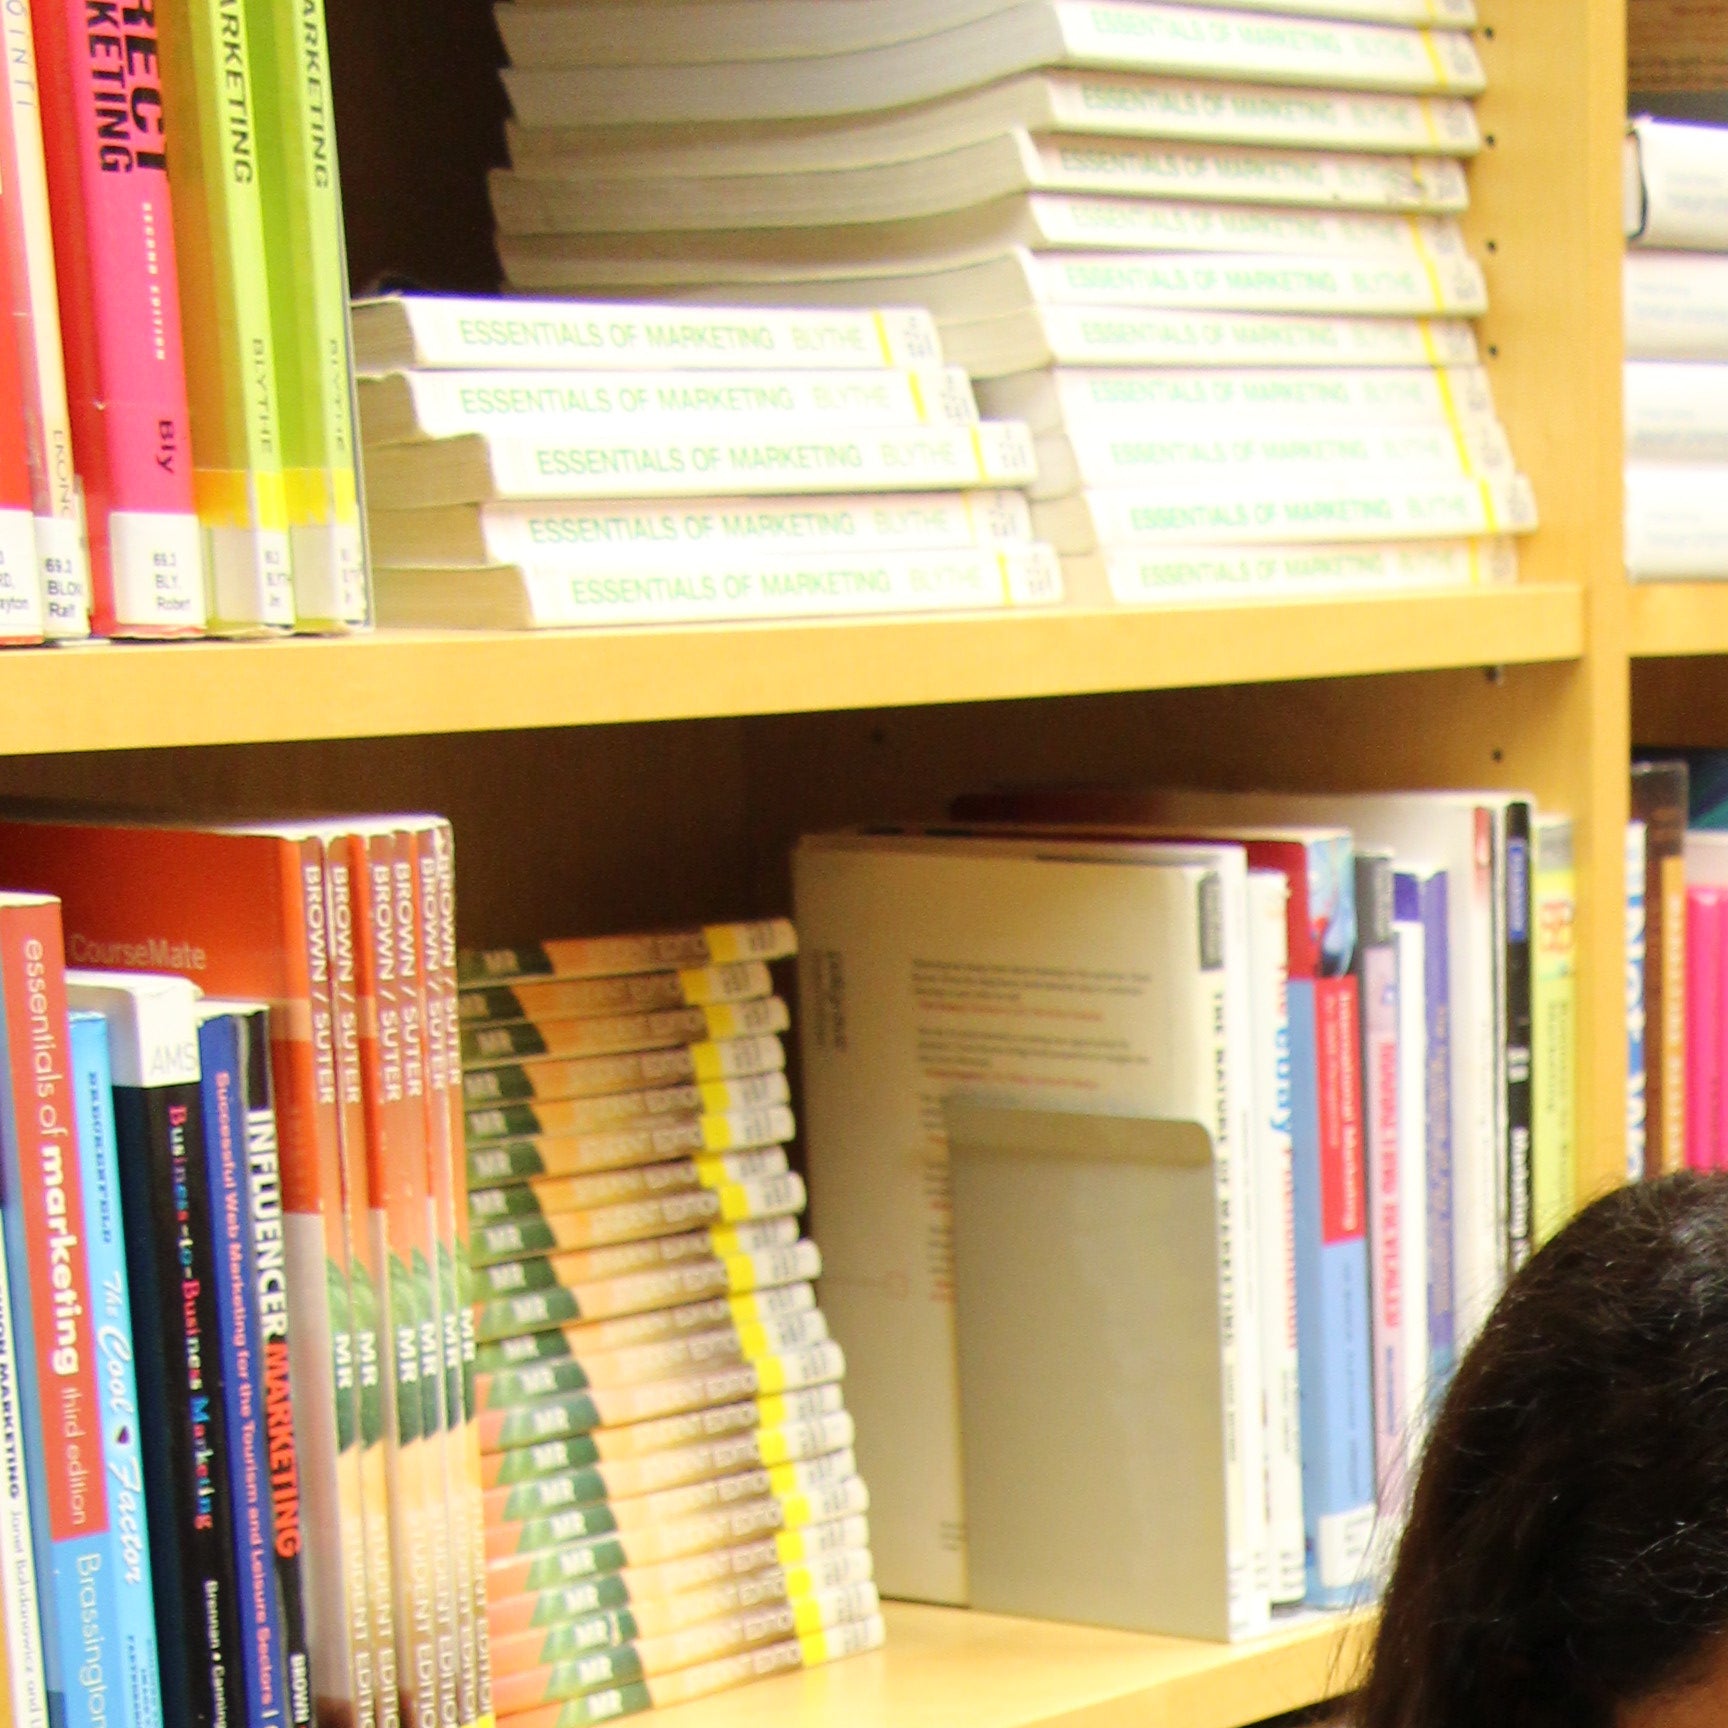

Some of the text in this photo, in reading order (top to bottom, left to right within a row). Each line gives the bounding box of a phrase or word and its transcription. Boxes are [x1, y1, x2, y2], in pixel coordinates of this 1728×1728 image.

[460, 319, 774, 350] ESSENTIALS OF MARKETING
[157, 419, 179, 474] Bly
[461, 388, 794, 415] ESSENTIALS OF MARKETING
[536, 444, 863, 476] ESSENTIALS OF MARKETING
[529, 513, 856, 544] ESSENTIALS OF MARKETING
[572, 571, 891, 605] ESSENTIALS OF MARKETING
[70, 934, 207, 971] CourseMate
[303, 864, 329, 983] BROWN
[331, 865, 354, 983] BROWN
[371, 863, 396, 982] BROWN
[393, 861, 417, 978] BROWN
[150, 1043, 198, 1073] AMS
[25, 938, 84, 1377] essentials of marketing
[167, 1104, 217, 1531] Business-to-Business Marketing
[229, 1241, 248, 1348] Marketing
[246, 1109, 302, 1560] INFLUENCER MARKETING
[60, 1387, 90, 1526] third edition
[98, 1325, 144, 1586] Cool Factor
[290, 1652, 311, 1724] BROWN
